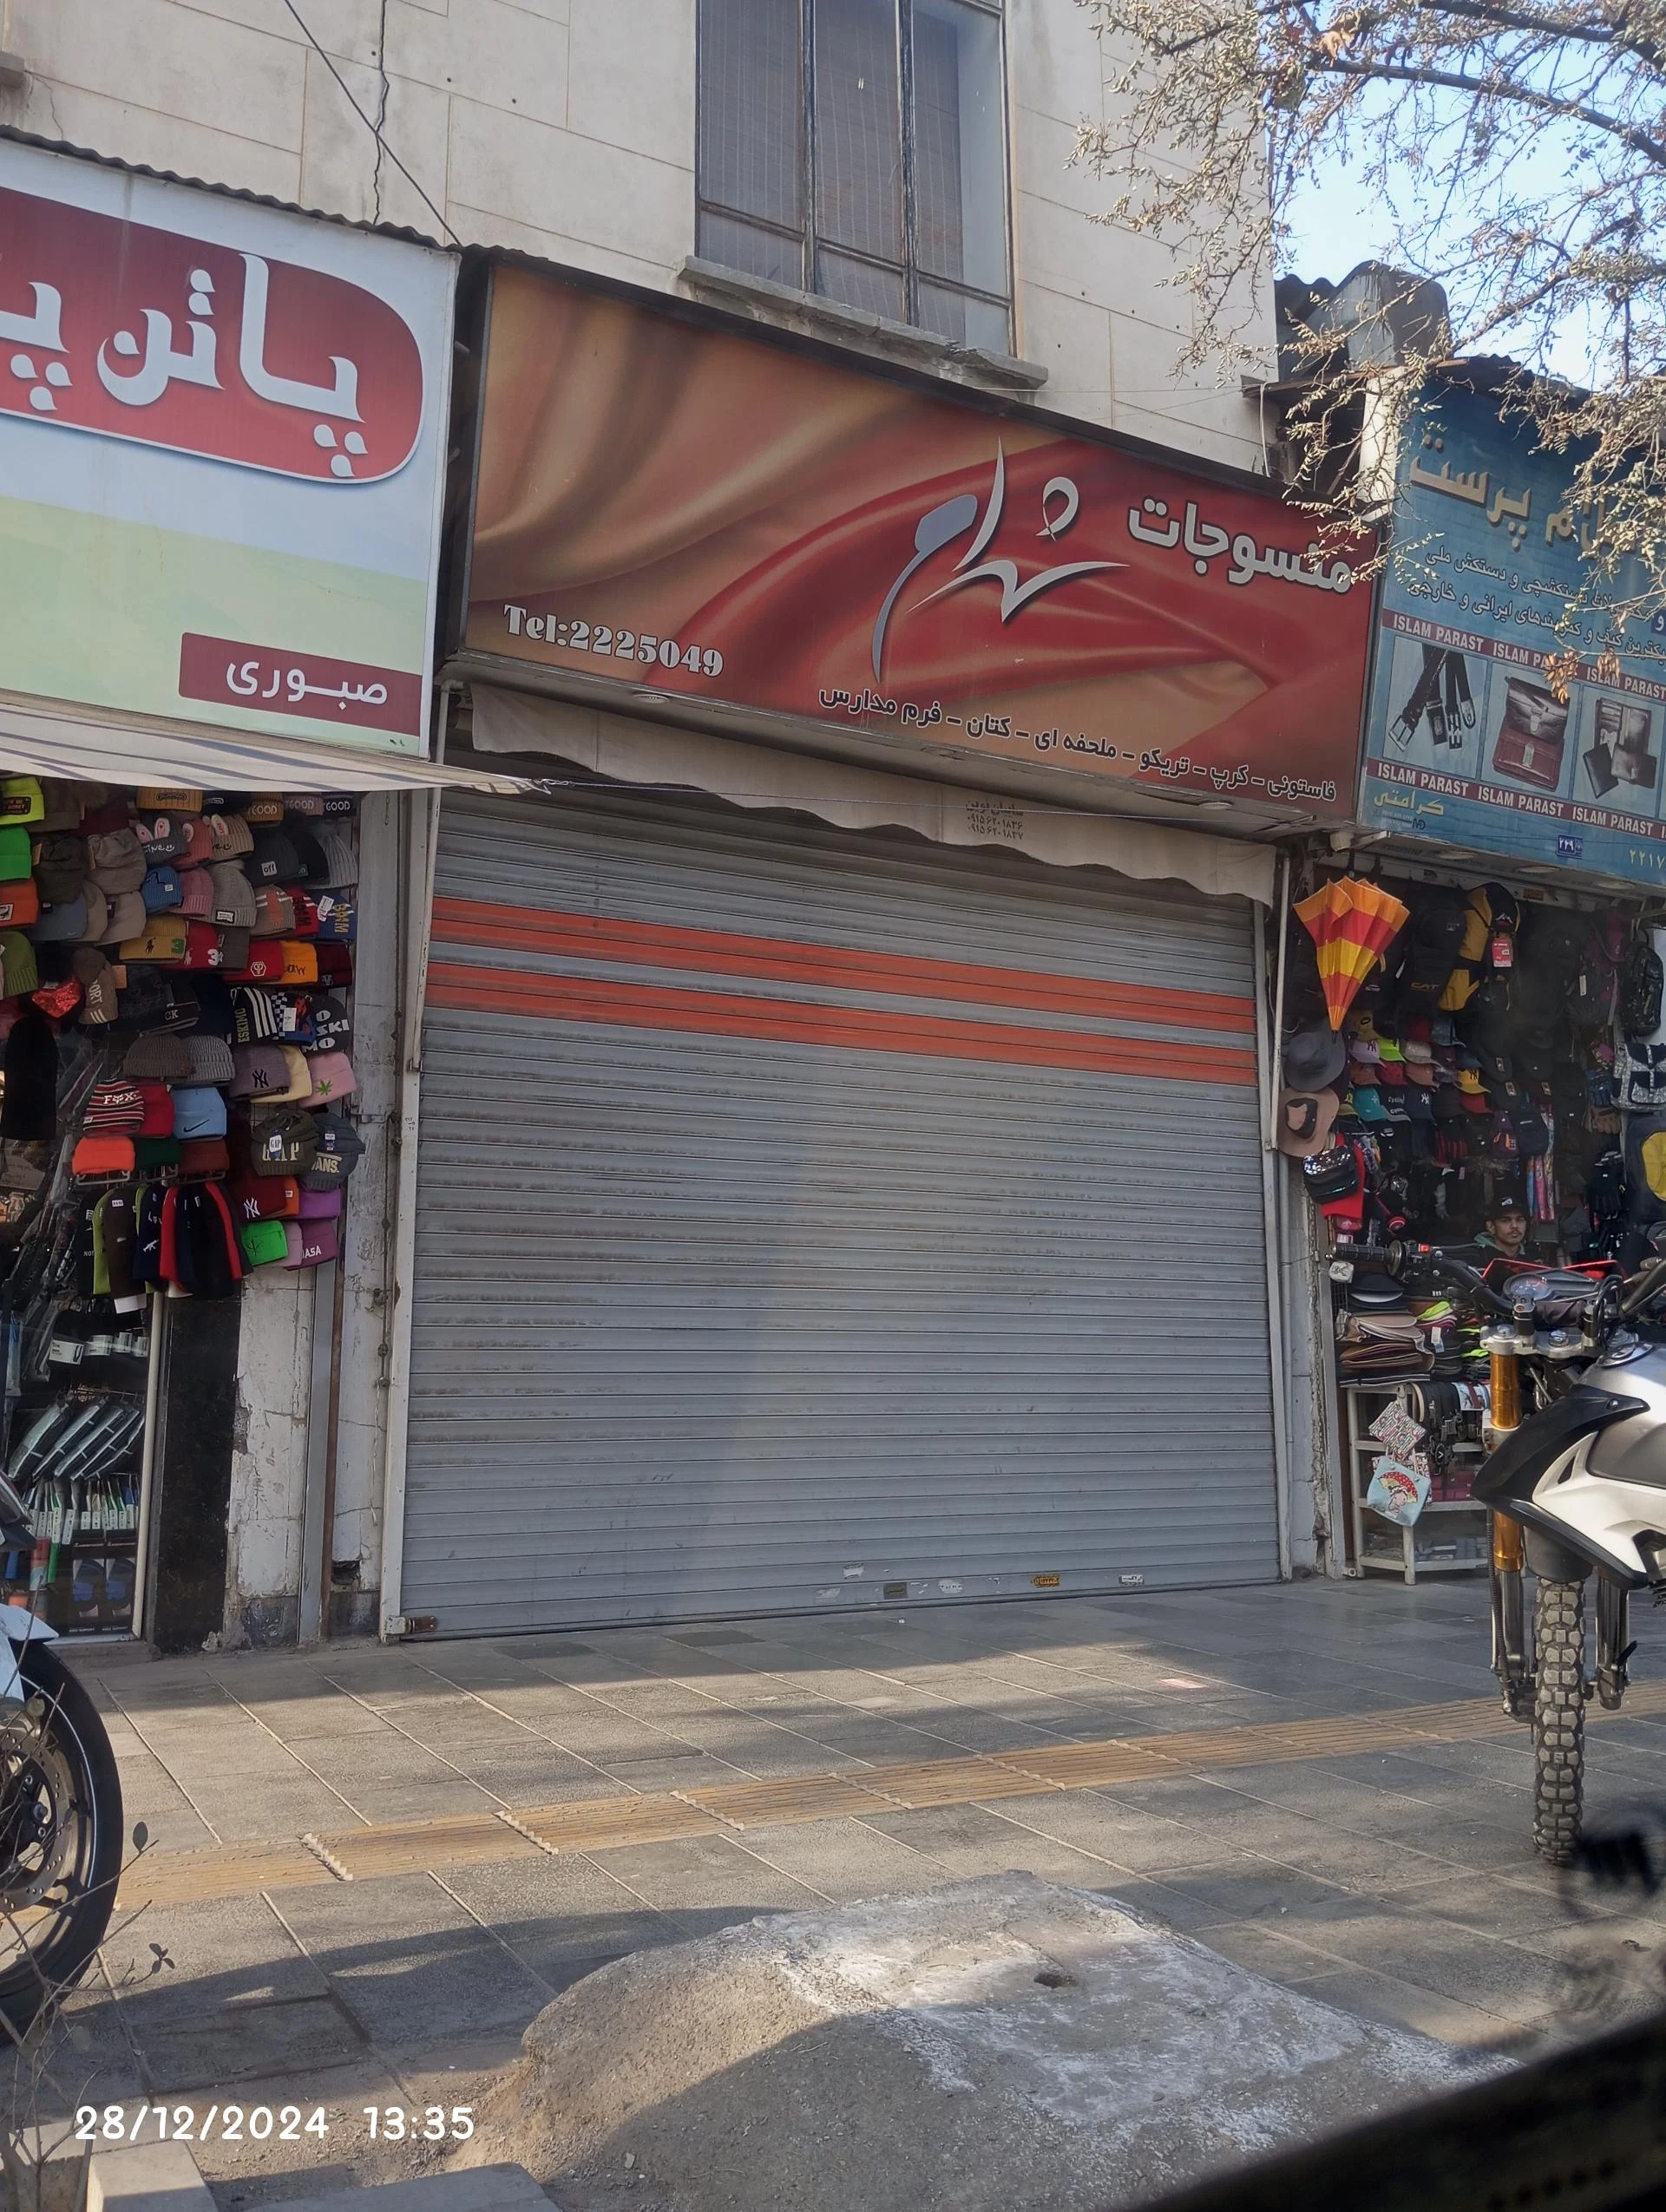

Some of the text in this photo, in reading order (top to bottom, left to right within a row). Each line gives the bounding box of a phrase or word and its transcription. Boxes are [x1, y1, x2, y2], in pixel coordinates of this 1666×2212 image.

[96, 253, 367, 477] پاتن
[1409, 434, 1532, 551] پرست
[1127, 496, 1354, 594] منسوجات
[1426, 546, 1451, 565] ملی
[1453, 552, 1506, 580] دستکش
[1473, 594, 1512, 623] ایرانی
[503, 605, 724, 677] Tel:2225049
[1394, 613, 1529, 664] ISLAM PARAST ISLAM
[226, 659, 389, 710] صبوری
[818, 688, 897, 716] مدارس
[901, 701, 941, 728] فرم
[966, 715, 1011, 739] کتان
[1033, 729, 1058, 752] ای
[1061, 732, 1118, 759] ملحفه
[1139, 749, 1190, 778] تریکو
[1210, 765, 1249, 789] کرپ
[1268, 777, 1337, 802] فاستونی
[1378, 762, 1416, 786] ISLAM
[1420, 773, 1468, 797] PARAST
[1478, 786, 1513, 807] ISLAM
[1518, 795, 1564, 817] PARAST
[1572, 807, 1605, 825] ISLAM
[1610, 815, 1653, 836] PARAST
